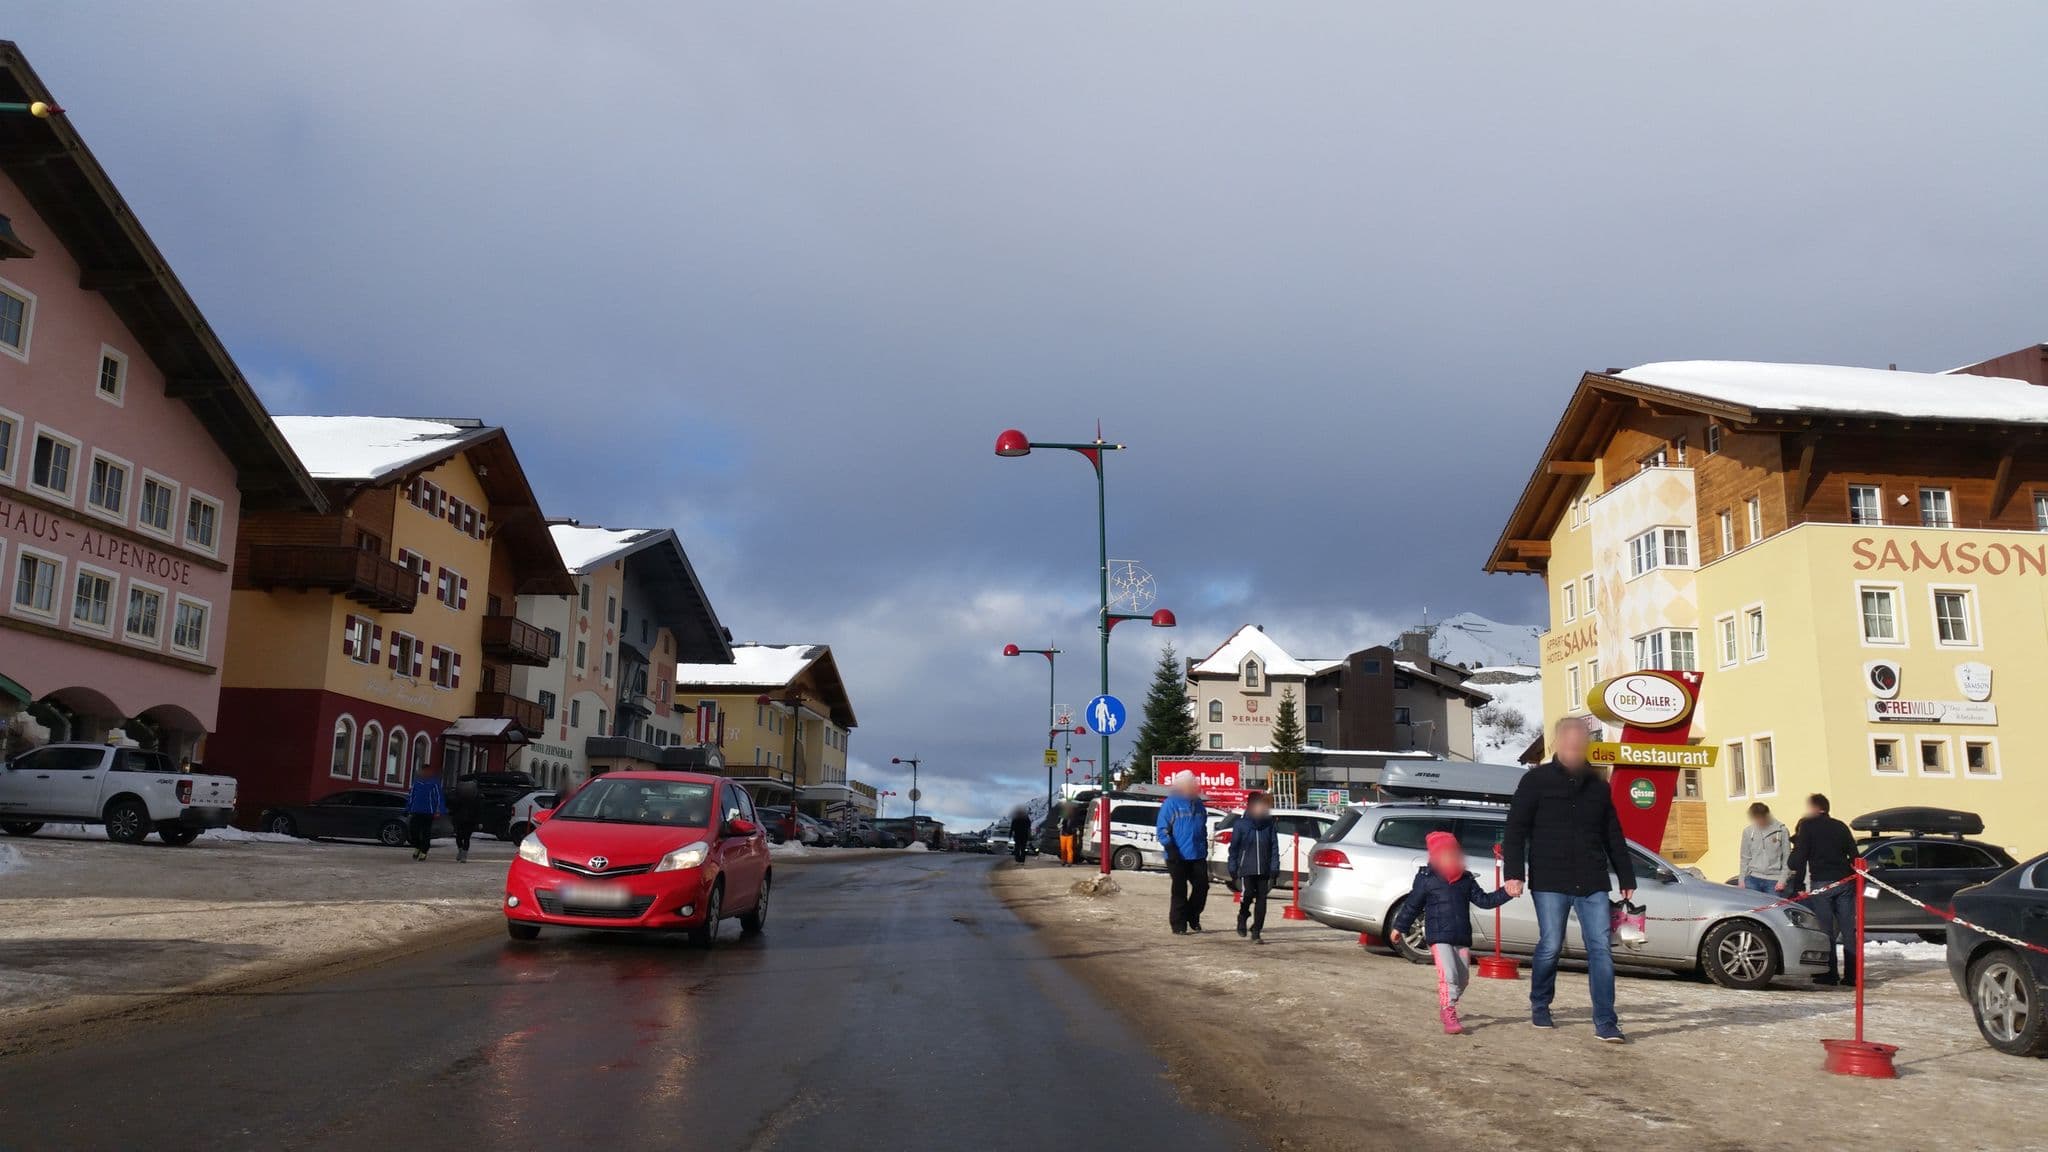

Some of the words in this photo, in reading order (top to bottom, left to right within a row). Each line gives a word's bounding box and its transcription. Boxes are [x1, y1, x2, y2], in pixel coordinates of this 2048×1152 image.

[80, 531, 190, 586] ALPENROSE
[1852, 537, 2047, 577] SAMSON
[1620, 695, 1637, 706] DER
[1887, 701, 1935, 716] FREIWILD
[1232, 715, 1272, 724] PERNER
[1592, 748, 1616, 761] das
[1620, 745, 1709, 765] Restaurant
